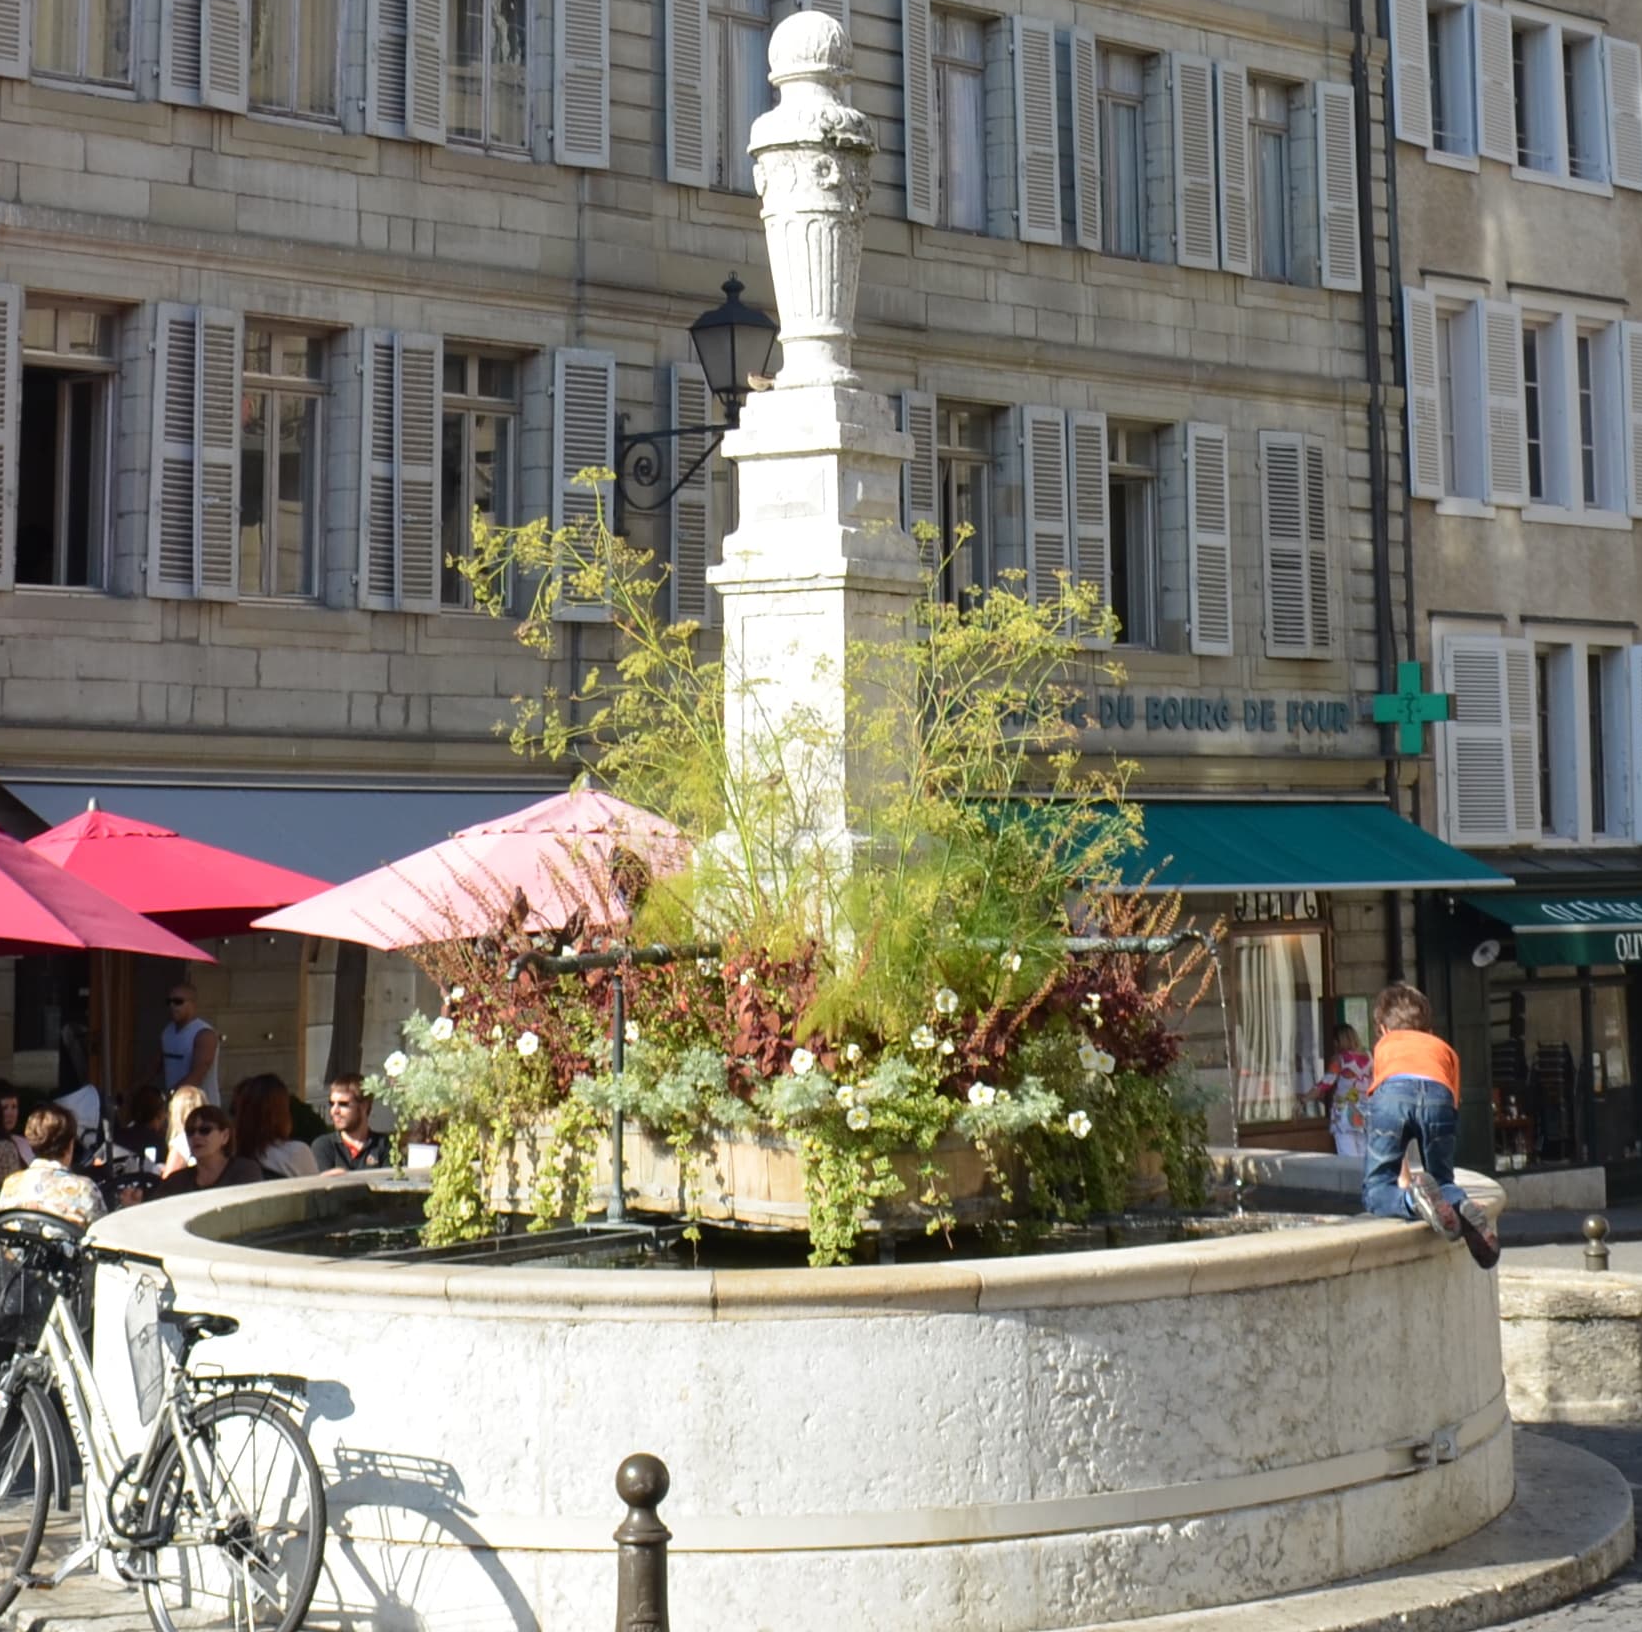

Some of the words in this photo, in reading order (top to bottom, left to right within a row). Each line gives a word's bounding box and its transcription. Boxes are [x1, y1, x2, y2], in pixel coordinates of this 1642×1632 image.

[1099, 695, 1134, 730] DU
[1145, 696, 1232, 732] BOURG
[1243, 699, 1276, 733] DE
[1286, 700, 1349, 734] FOUR
